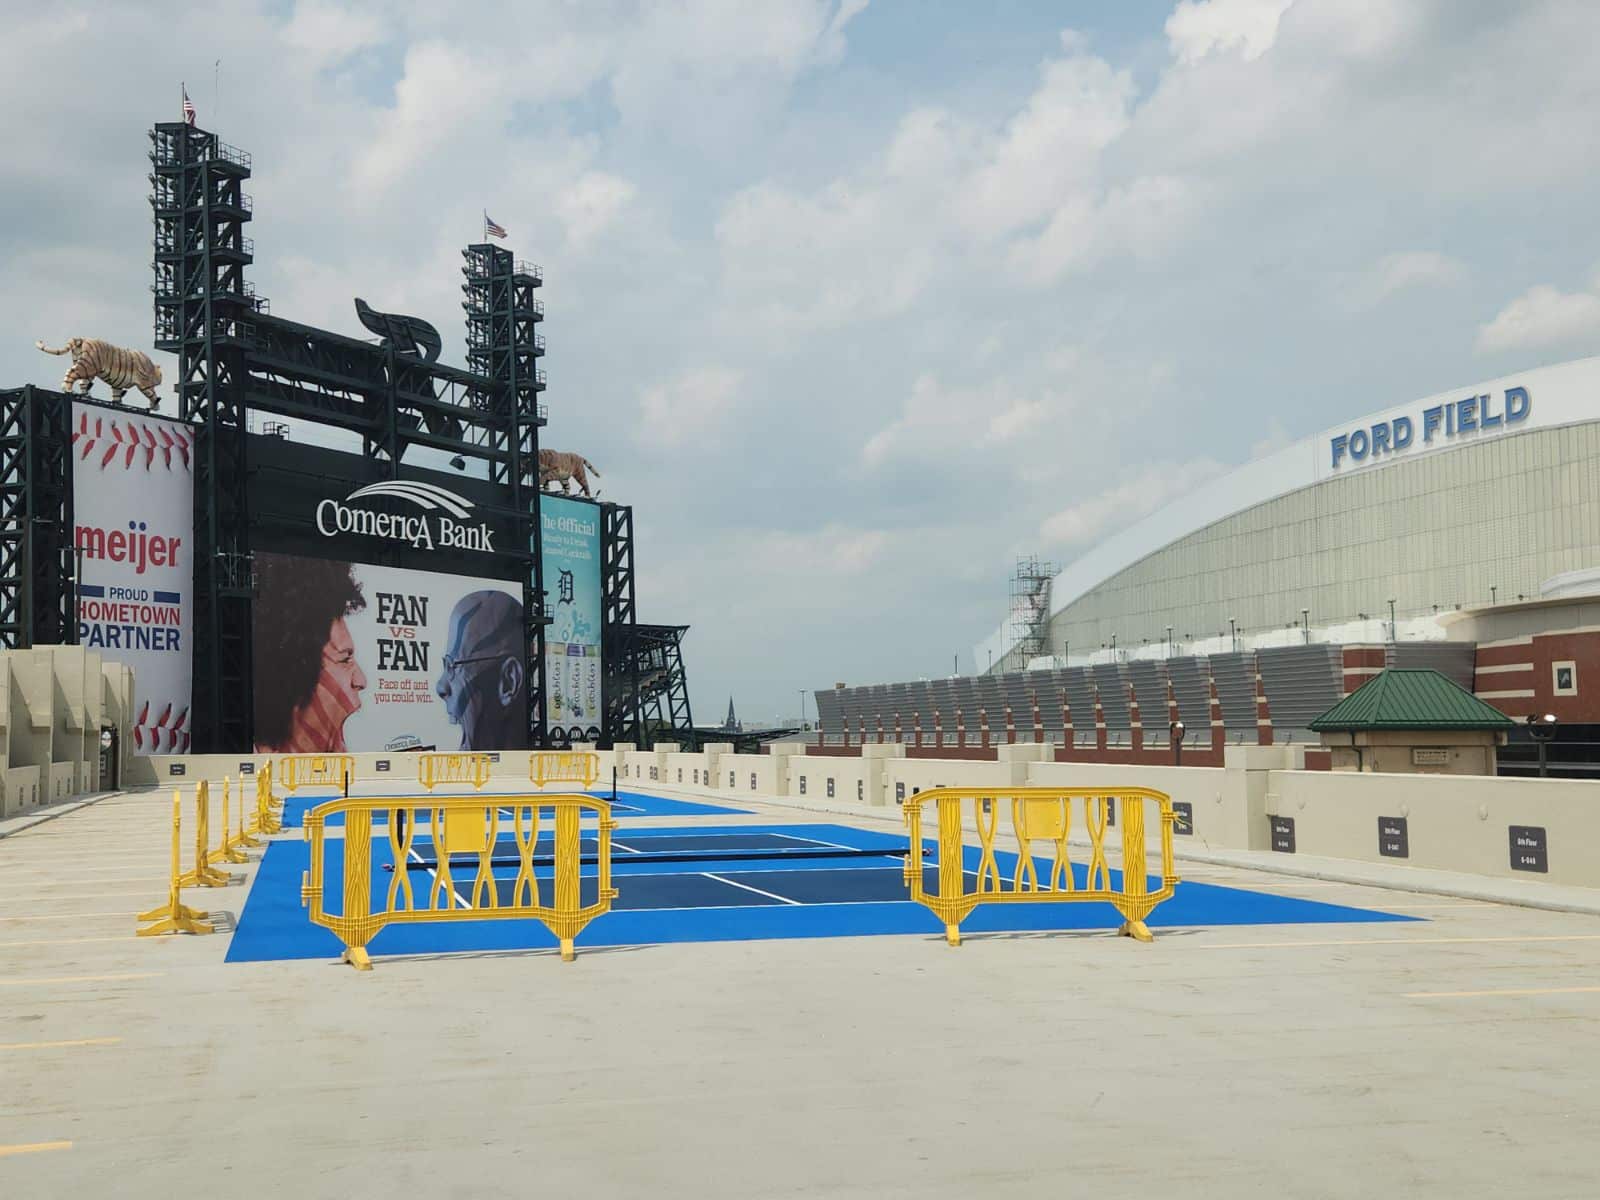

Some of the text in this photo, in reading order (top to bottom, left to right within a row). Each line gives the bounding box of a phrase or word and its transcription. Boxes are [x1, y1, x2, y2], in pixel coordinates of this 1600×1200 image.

[1331, 386, 1532, 469] FORD FIELD
[76, 520, 182, 575] meijer
[439, 516, 495, 553] Bank
[109, 587, 148, 602] PROUD
[79, 600, 181, 626] HOMETOWN
[375, 592, 429, 627] FAN
[79, 622, 181, 651] PARTNER
[389, 626, 416, 639] VS
[376, 639, 430, 672] FAN
[374, 692, 390, 704] you
[392, 691, 415, 703] could
[378, 678, 429, 690] Face off and
